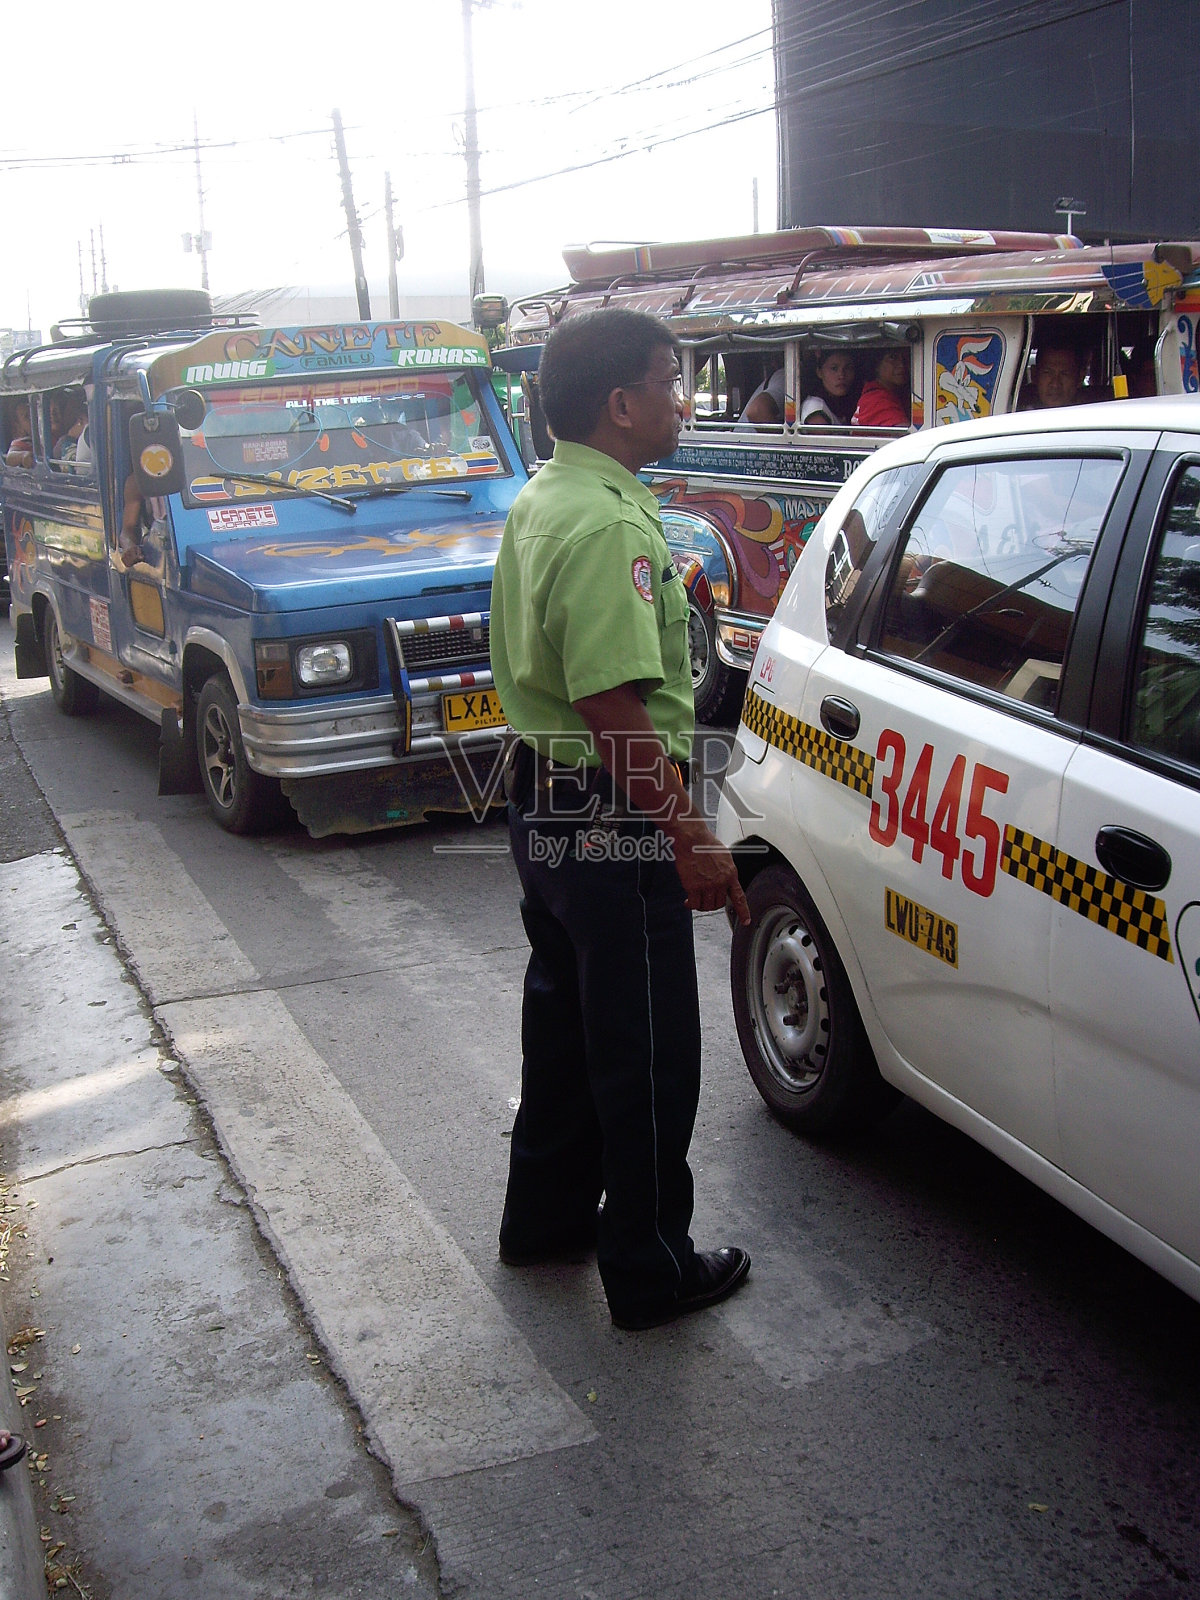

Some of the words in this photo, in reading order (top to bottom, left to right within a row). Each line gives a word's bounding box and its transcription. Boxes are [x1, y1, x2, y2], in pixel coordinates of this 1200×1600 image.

[398, 347, 479, 367] ROXAS
[231, 457, 458, 496] SUZETTE
[868, 728, 1010, 898] 3445
